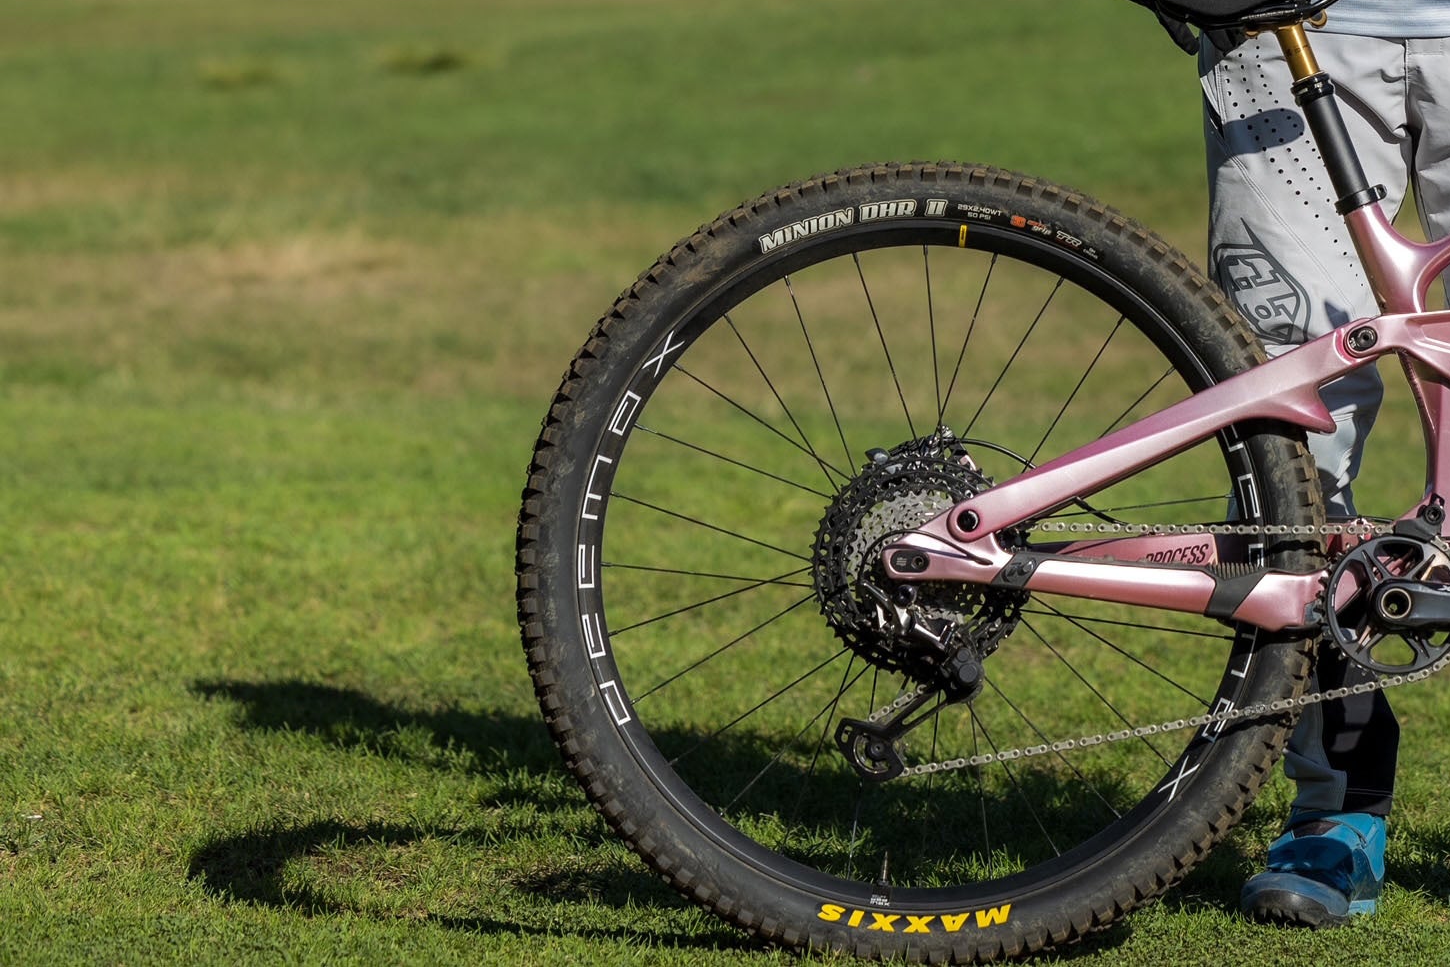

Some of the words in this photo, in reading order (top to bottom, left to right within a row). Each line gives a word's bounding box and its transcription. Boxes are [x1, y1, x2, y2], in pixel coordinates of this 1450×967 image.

[758, 206, 855, 254] MINION
[859, 198, 918, 223] DHR
[816, 902, 1012, 933] MAXXIS
